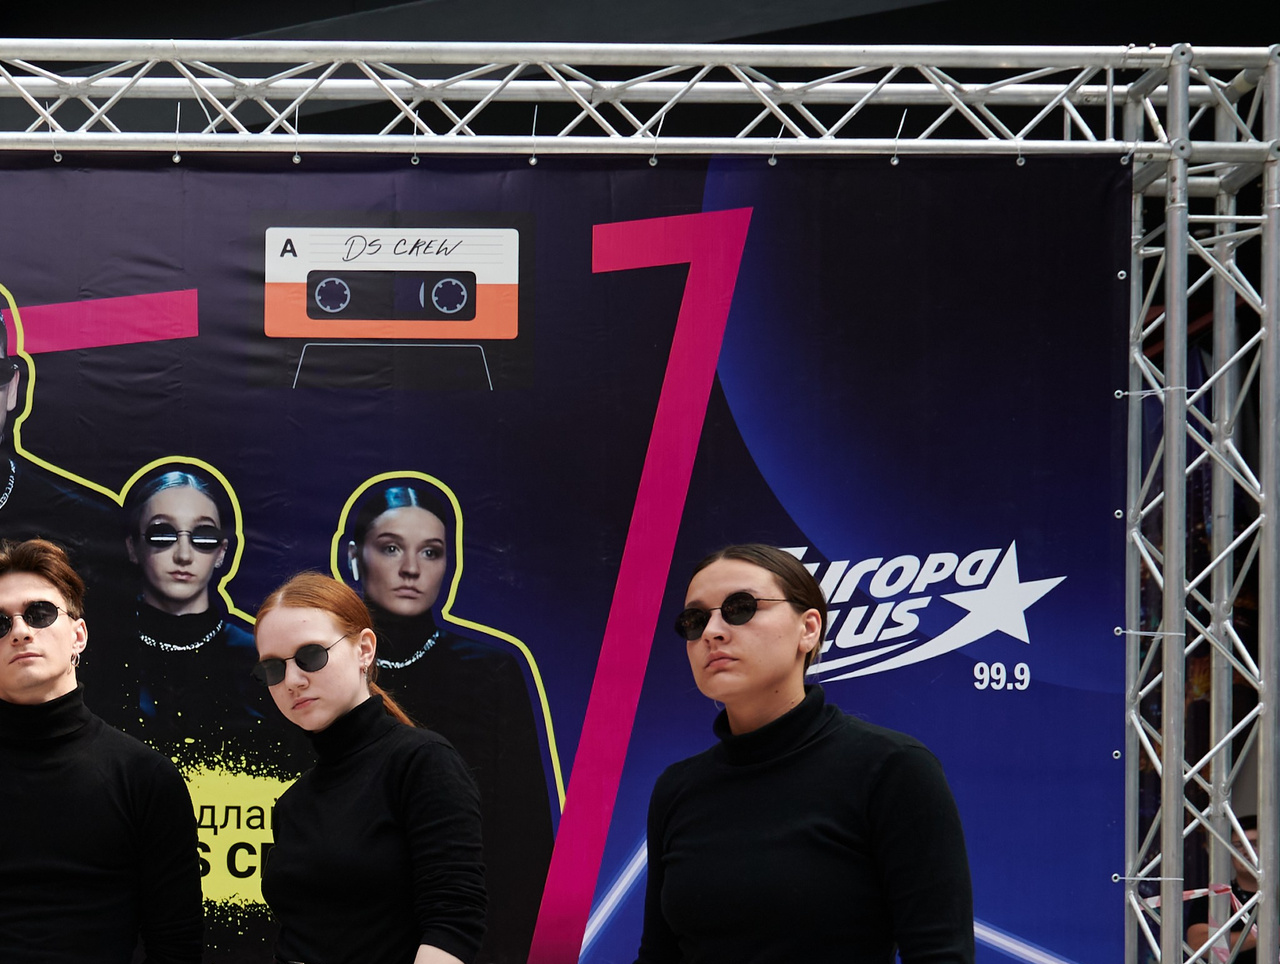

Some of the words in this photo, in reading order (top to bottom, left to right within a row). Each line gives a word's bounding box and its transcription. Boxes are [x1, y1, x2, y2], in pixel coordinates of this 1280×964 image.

[279, 238, 298, 258] A
[342, 235, 382, 262] DS
[393, 238, 463, 257] CREW
[973, 662, 1031, 691] 99.9
